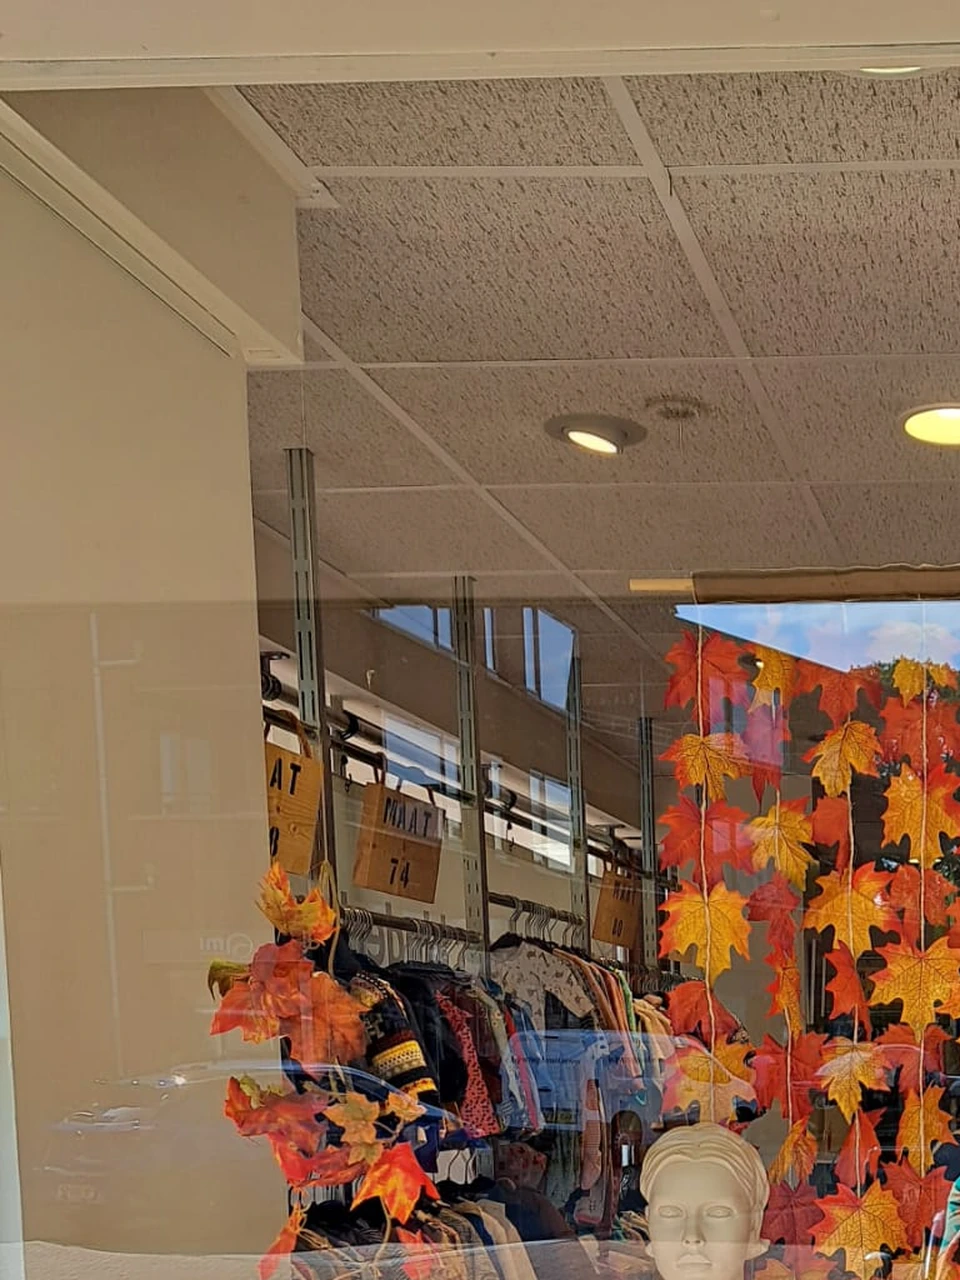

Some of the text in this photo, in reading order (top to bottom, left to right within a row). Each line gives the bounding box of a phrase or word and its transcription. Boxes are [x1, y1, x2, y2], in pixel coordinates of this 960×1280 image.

[269, 757, 302, 796] AT
[383, 796, 432, 838] MAAT
[389, 857, 410, 889] 74
